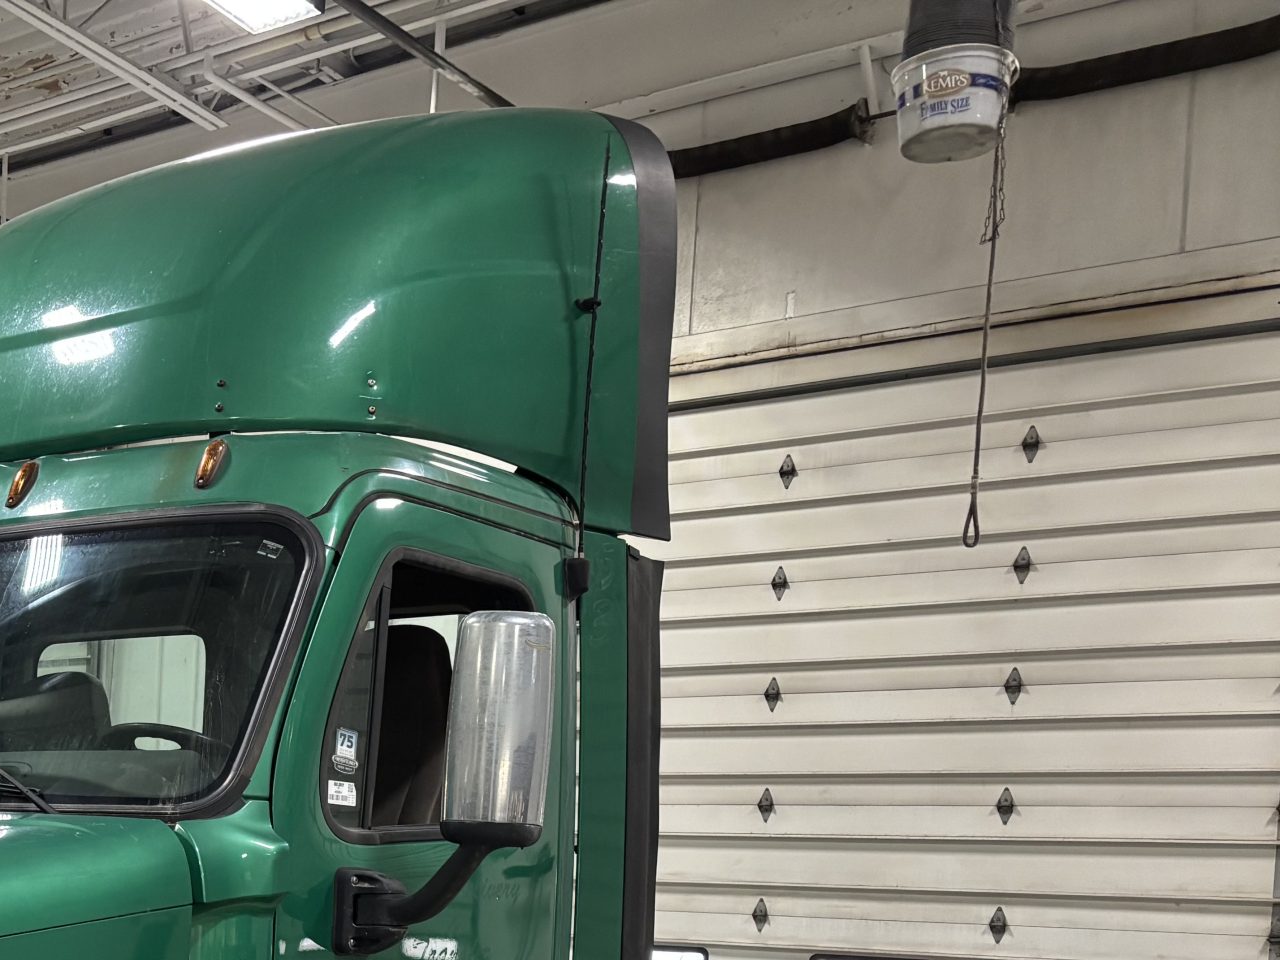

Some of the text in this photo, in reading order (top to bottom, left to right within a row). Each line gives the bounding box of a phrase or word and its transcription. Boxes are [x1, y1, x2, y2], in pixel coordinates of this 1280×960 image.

[923, 74, 967, 94] KEMPS
[950, 96, 970, 114] SIZE
[339, 733, 353, 748] 75
